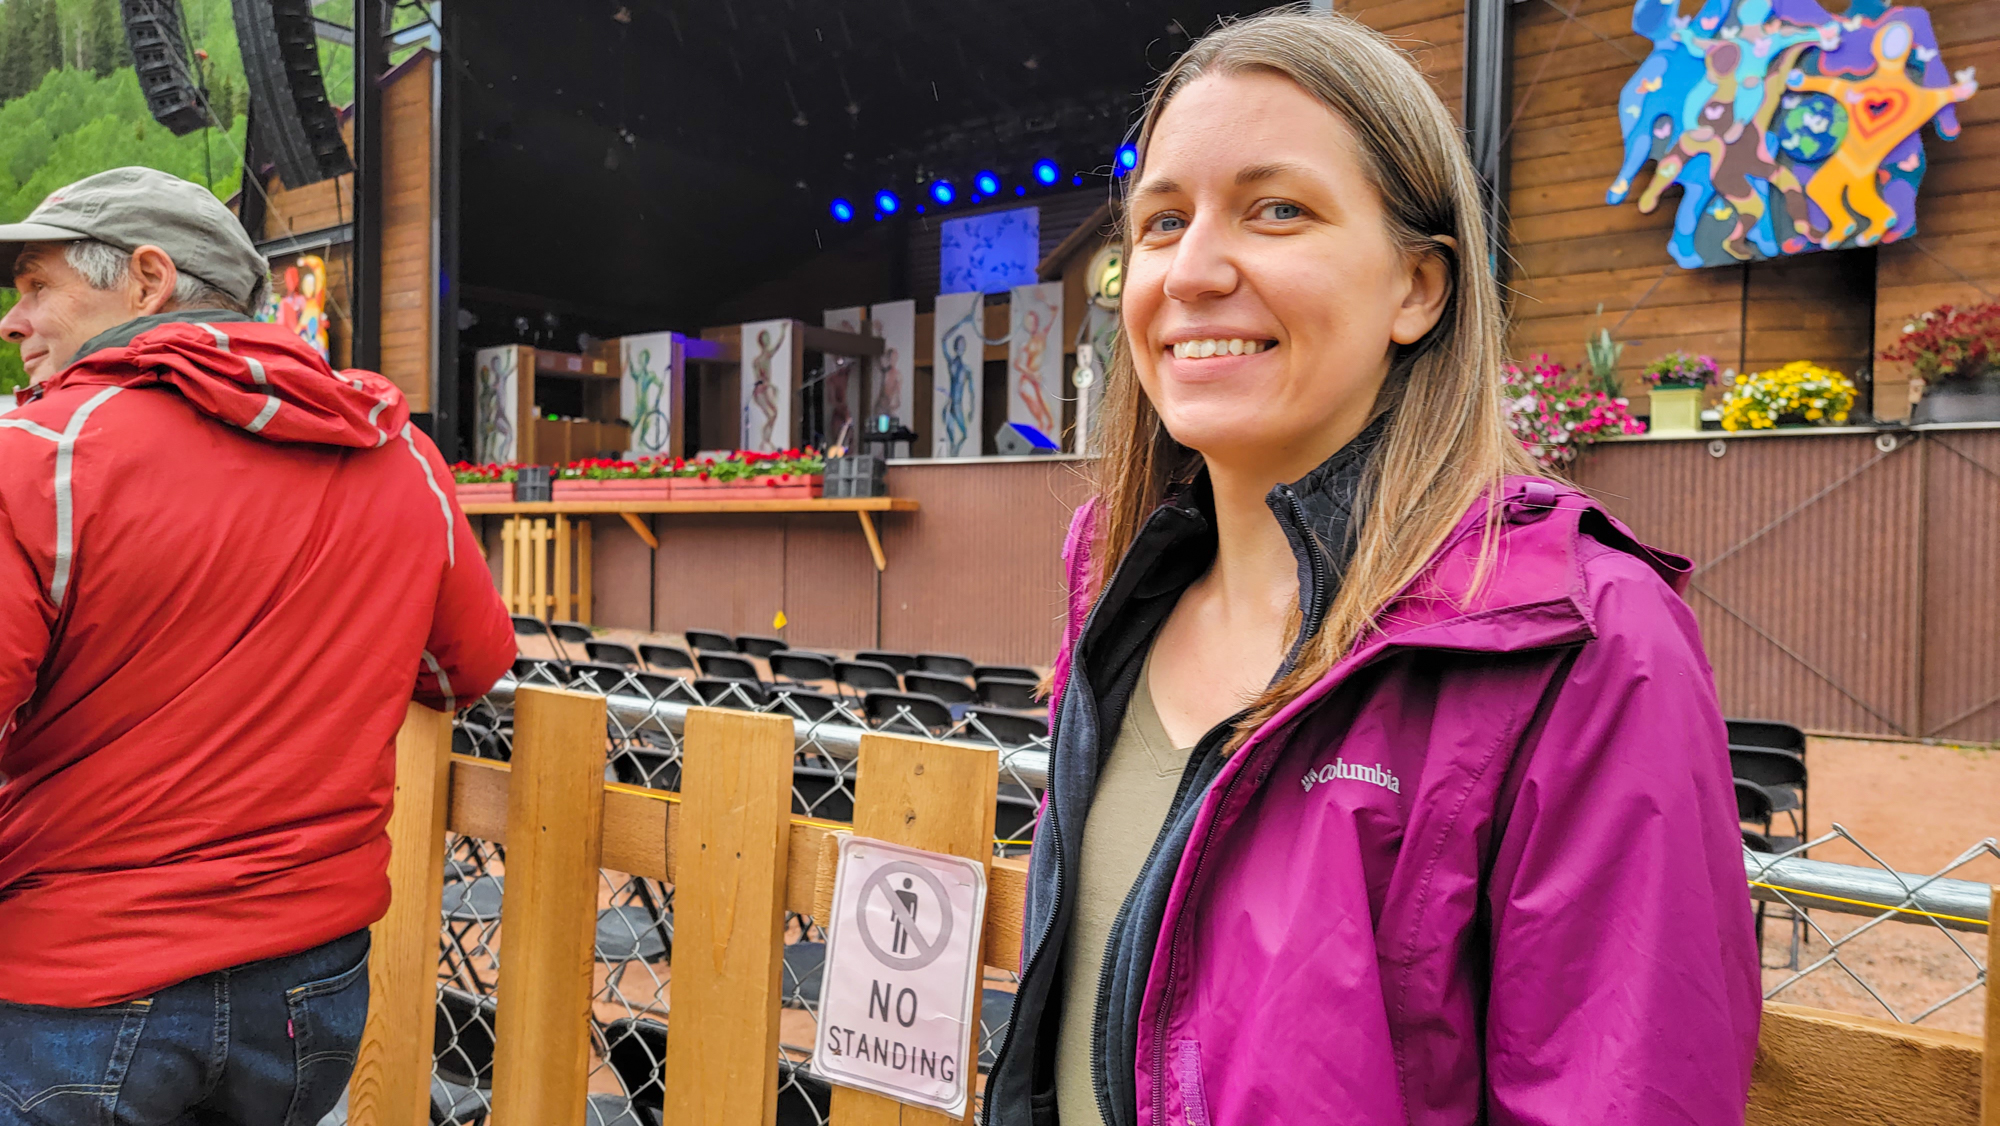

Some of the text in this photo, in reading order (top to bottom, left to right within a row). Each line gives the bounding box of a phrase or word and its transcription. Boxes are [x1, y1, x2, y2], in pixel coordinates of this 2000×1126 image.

[1318, 757, 1400, 793] Columbia
[868, 979, 918, 1028] NO
[828, 1026, 955, 1082] STANDING
